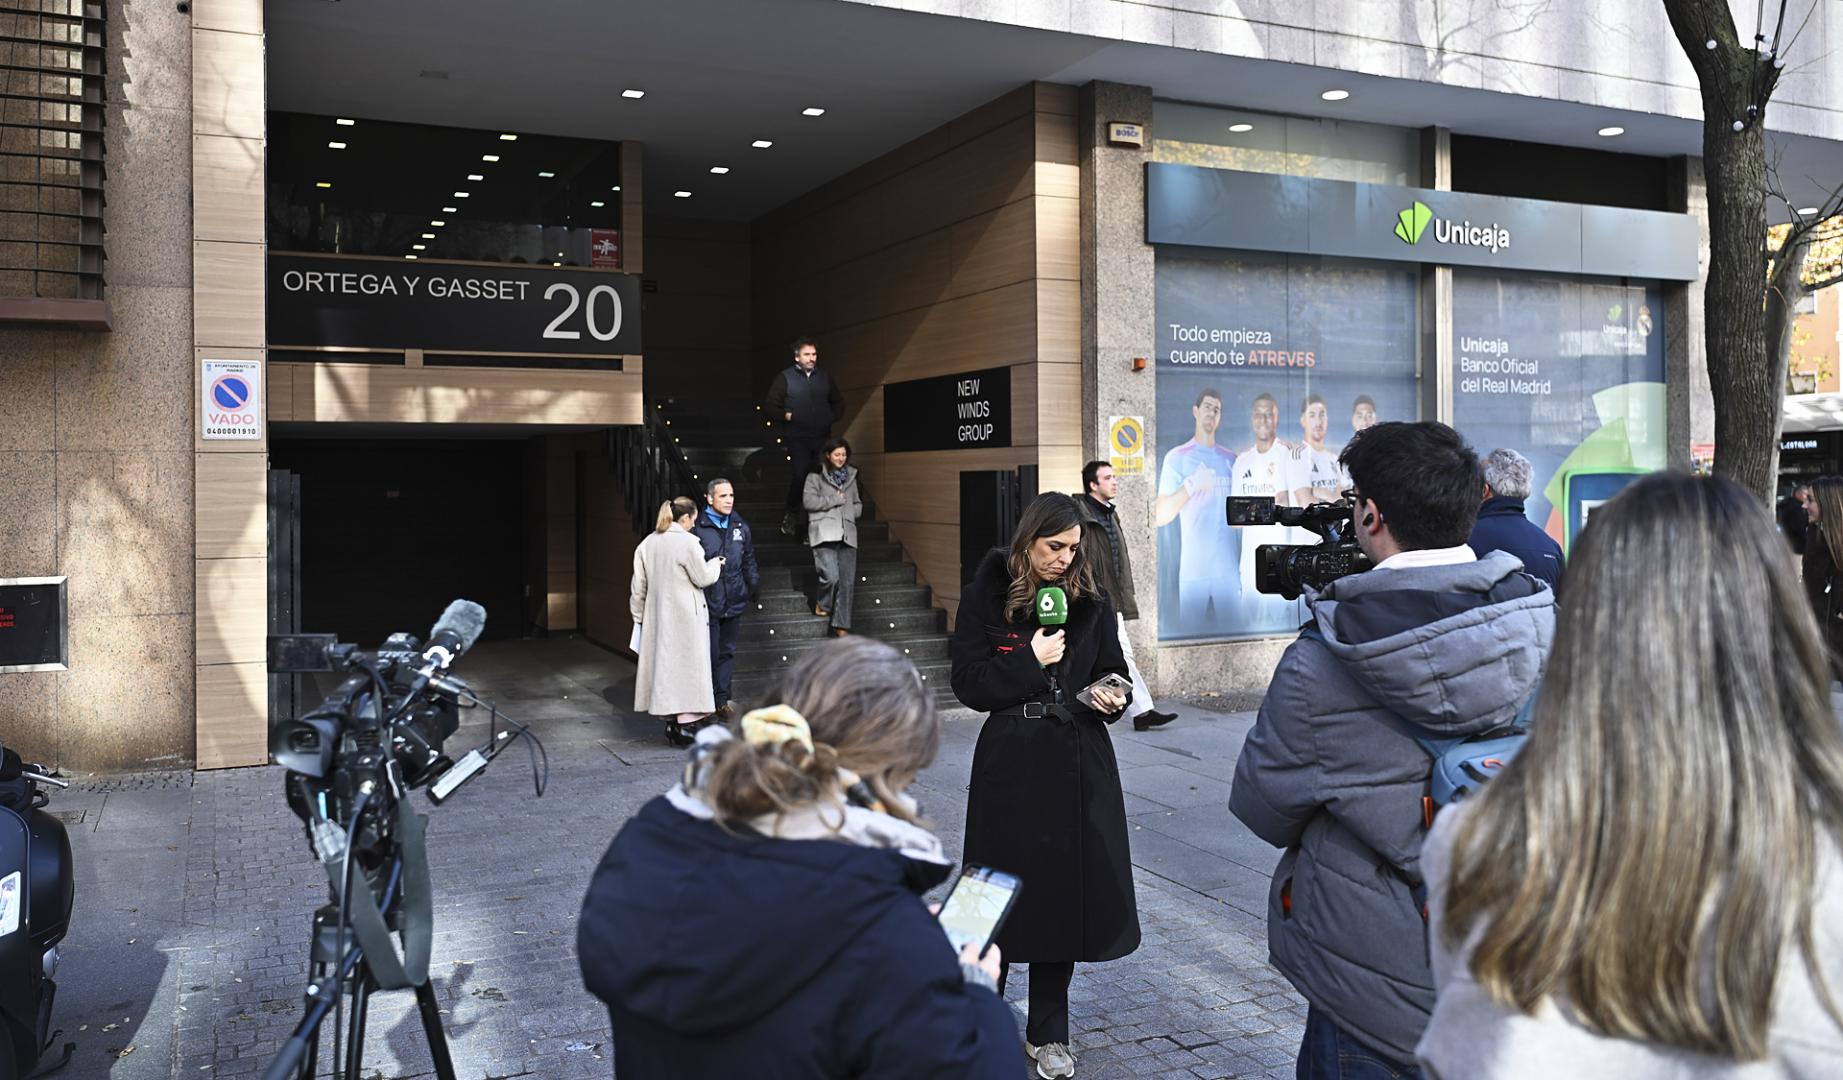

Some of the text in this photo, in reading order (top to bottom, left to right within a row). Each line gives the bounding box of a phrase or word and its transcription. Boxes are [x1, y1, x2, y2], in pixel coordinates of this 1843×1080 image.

[1434, 218, 1510, 254] Unicaja
[283, 270, 622, 342] ORTEGA Y GASSET 20
[1169, 324, 1272, 348] Todo empieza
[1460, 336, 1509, 357] Unicaja
[1169, 348, 1316, 368] cuando te ATREVES
[1460, 356, 1538, 375] Banco Oficial
[957, 378, 980, 397] NEW
[1460, 377, 1551, 395] del Real Madrid
[208, 413, 255, 425] VADO
[957, 400, 990, 419] WINDS
[206, 427, 256, 435] 0400001910
[958, 423, 993, 442] GROUP
[1242, 483, 1276, 495] Emirates
[1040, 592, 1055, 612] 6
